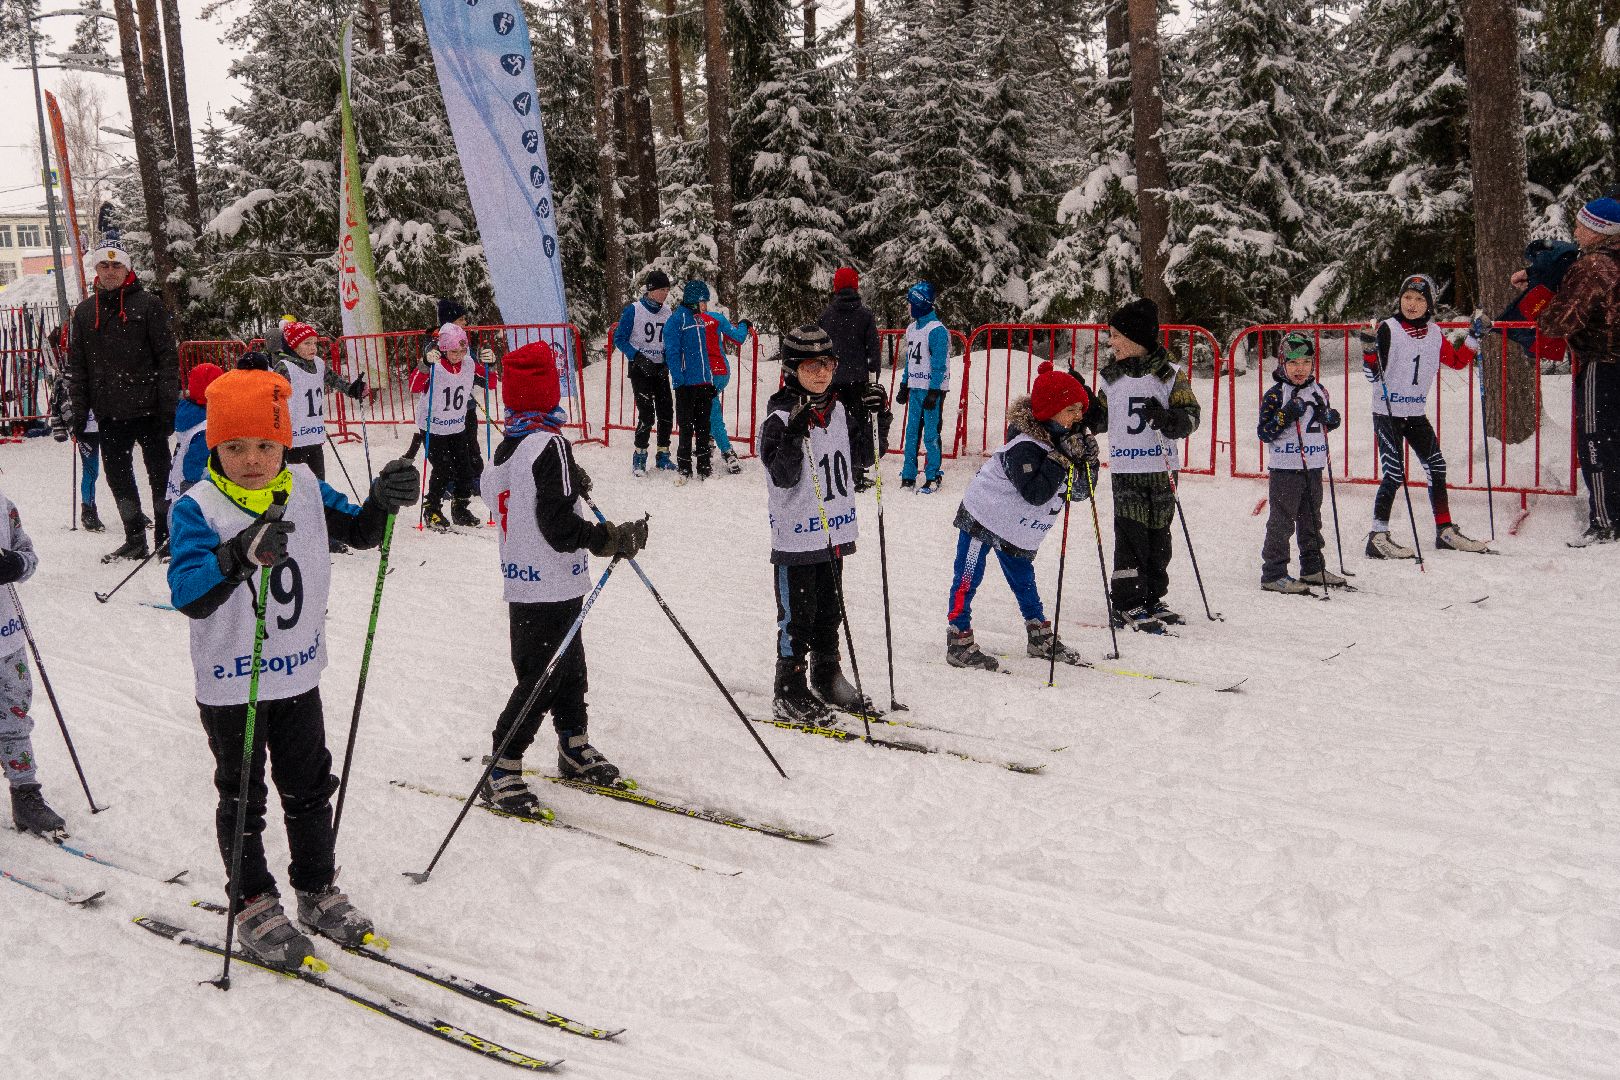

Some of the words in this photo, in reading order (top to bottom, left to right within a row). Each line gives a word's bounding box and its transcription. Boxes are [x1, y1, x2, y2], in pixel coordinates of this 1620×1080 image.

[644, 322, 664, 343] 97
[1412, 355, 1421, 385] 1
[442, 385, 465, 411] 16
[1126, 396, 1147, 435] 5
[1304, 400, 1322, 433] 2
[819, 449, 849, 502] 10
[270, 556, 304, 630] 9
